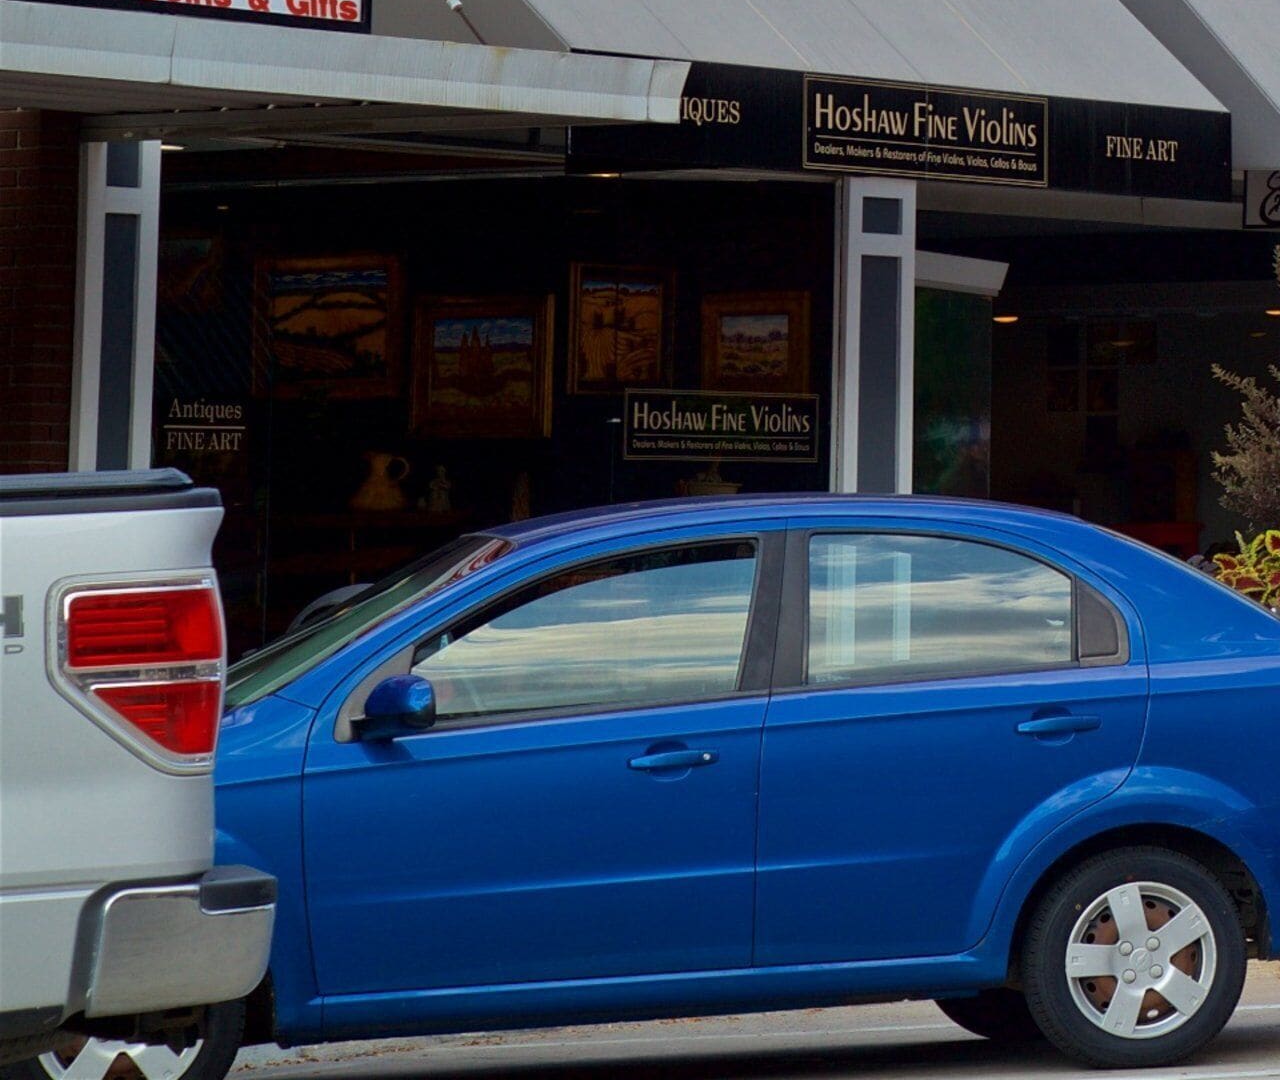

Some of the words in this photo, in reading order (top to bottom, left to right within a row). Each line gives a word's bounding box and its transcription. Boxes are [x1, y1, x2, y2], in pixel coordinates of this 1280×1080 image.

[682, 97, 741, 126] IQUES
[1106, 135, 1143, 159] FINE
[1146, 139, 1178, 162] ART
[168, 398, 242, 423] Antiques
[166, 431, 205, 451] FINE
[208, 432, 242, 451] ART
